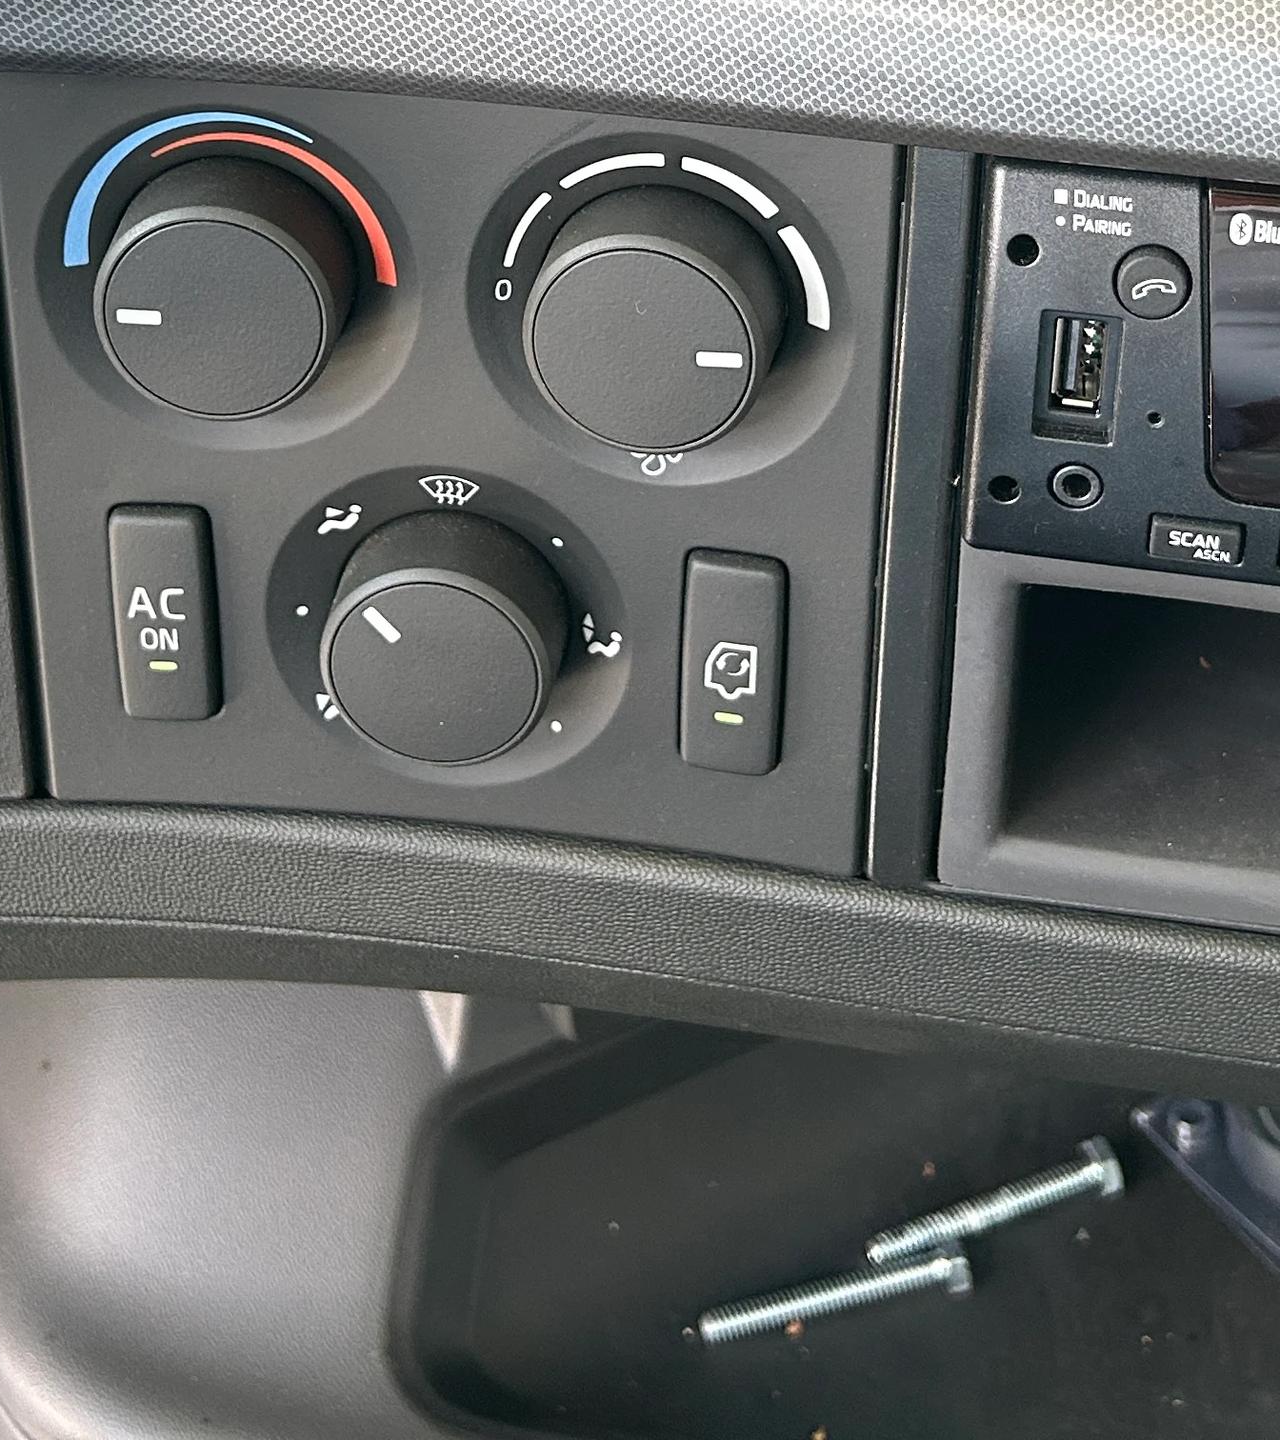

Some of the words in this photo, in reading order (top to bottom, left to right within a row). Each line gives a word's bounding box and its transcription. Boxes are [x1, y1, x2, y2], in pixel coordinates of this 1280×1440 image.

[1073, 189, 1133, 213] DIALING
[1072, 215, 1132, 237] PAIRING
[1168, 530, 1221, 549] SCAN
[1193, 547, 1231, 563] ASCN
[126, 586, 186, 621] AC
[139, 627, 179, 652] ON
